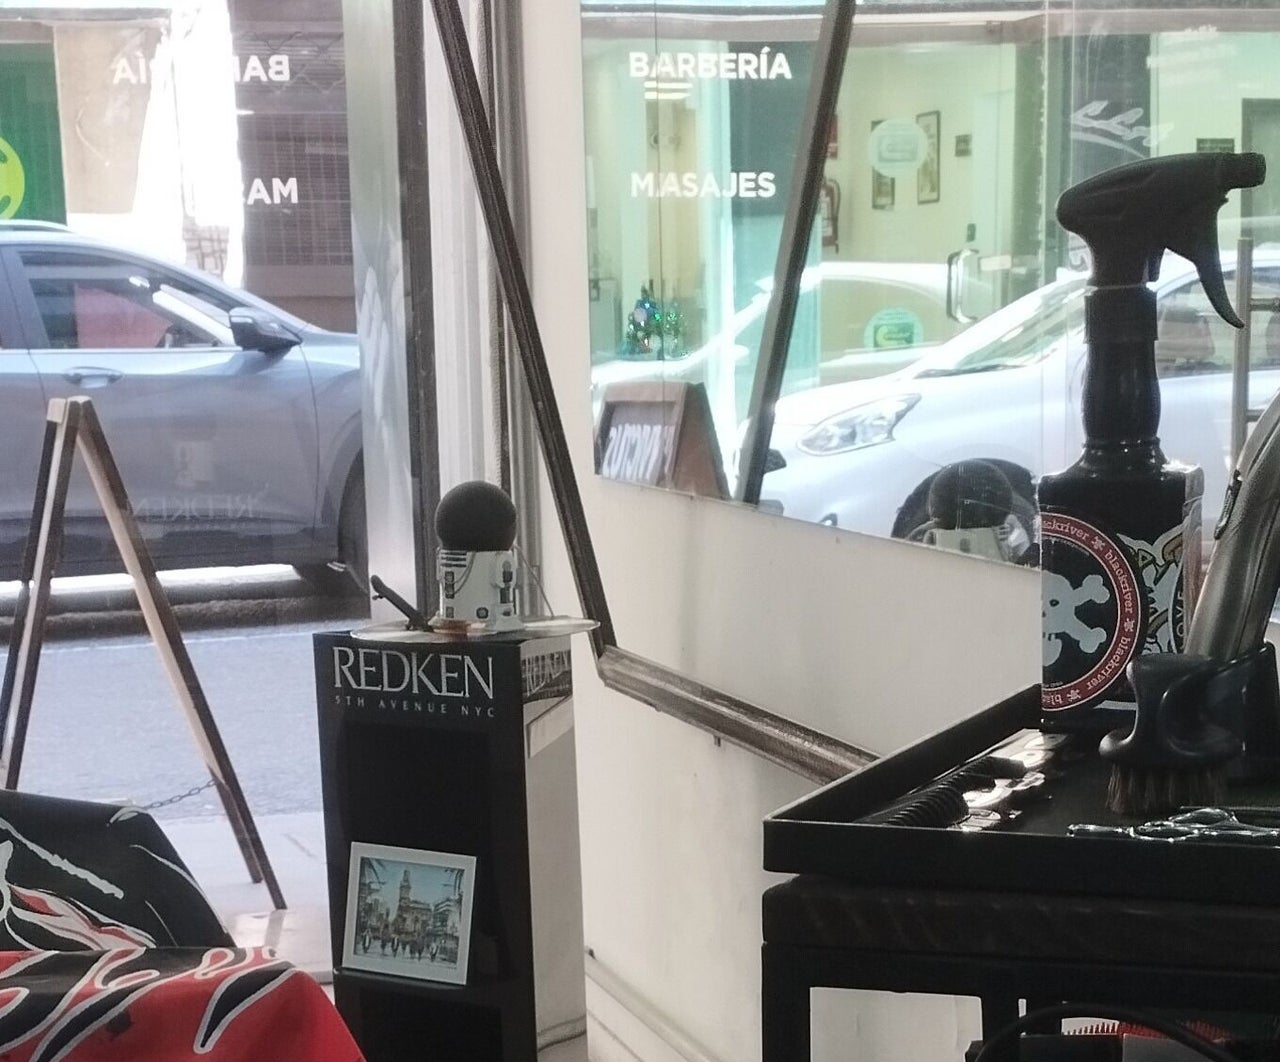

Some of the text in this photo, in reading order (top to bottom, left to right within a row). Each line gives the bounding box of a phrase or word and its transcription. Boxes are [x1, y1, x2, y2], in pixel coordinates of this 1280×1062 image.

[628, 46, 792, 80] BARBERÍA
[630, 171, 777, 198] MASAJES
[1104, 550, 1133, 614] blackriver
[332, 646, 494, 700] REDKEN
[1086, 636, 1132, 691] blackriver
[335, 695, 496, 718] 5TH AVENUE NYC
